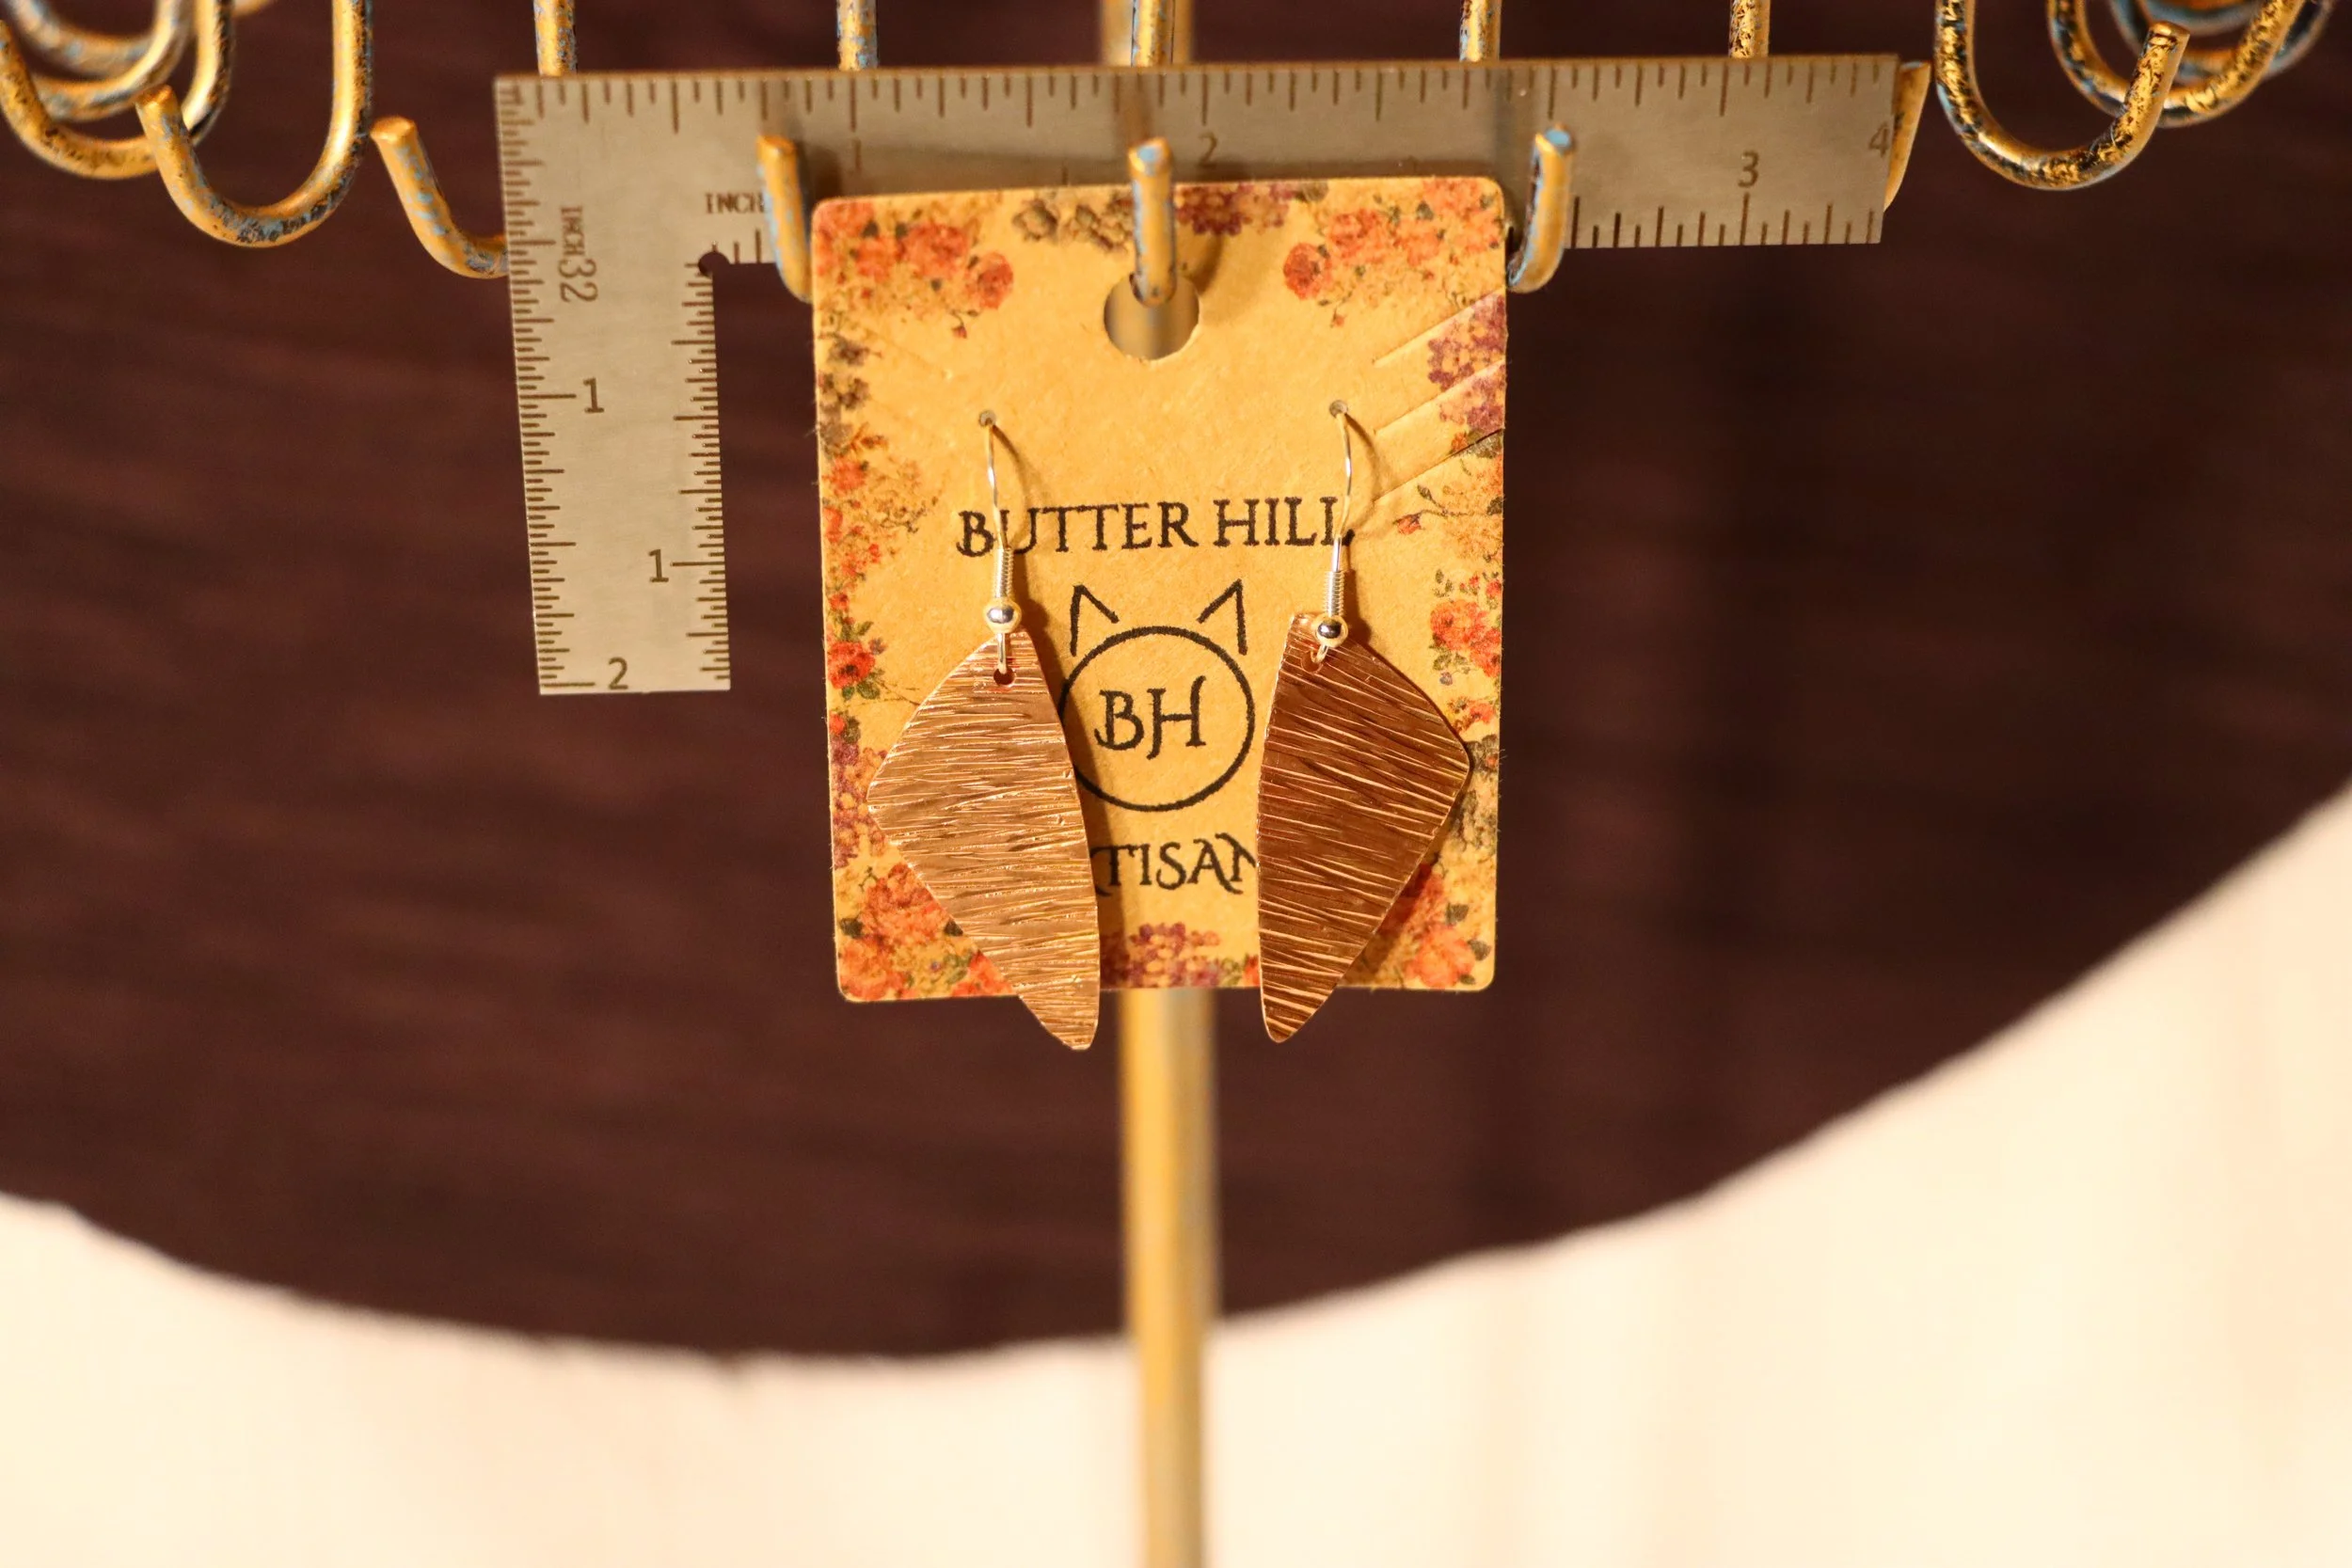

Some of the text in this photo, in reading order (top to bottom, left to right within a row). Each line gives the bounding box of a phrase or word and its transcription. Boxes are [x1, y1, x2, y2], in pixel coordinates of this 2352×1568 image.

[1197, 130, 1218, 169] 2
[1868, 121, 1889, 158] 4
[1738, 150, 1759, 188] 3
[705, 191, 765, 214] INCH
[558, 206, 598, 302] INCH 32
[583, 377, 605, 414] 1
[956, 496, 1355, 557] BUTTER HILL
[648, 548, 669, 583] 1
[607, 657, 628, 690] 2
[1094, 674, 1207, 760] BH
[1089, 832, 1257, 897] TISAN
